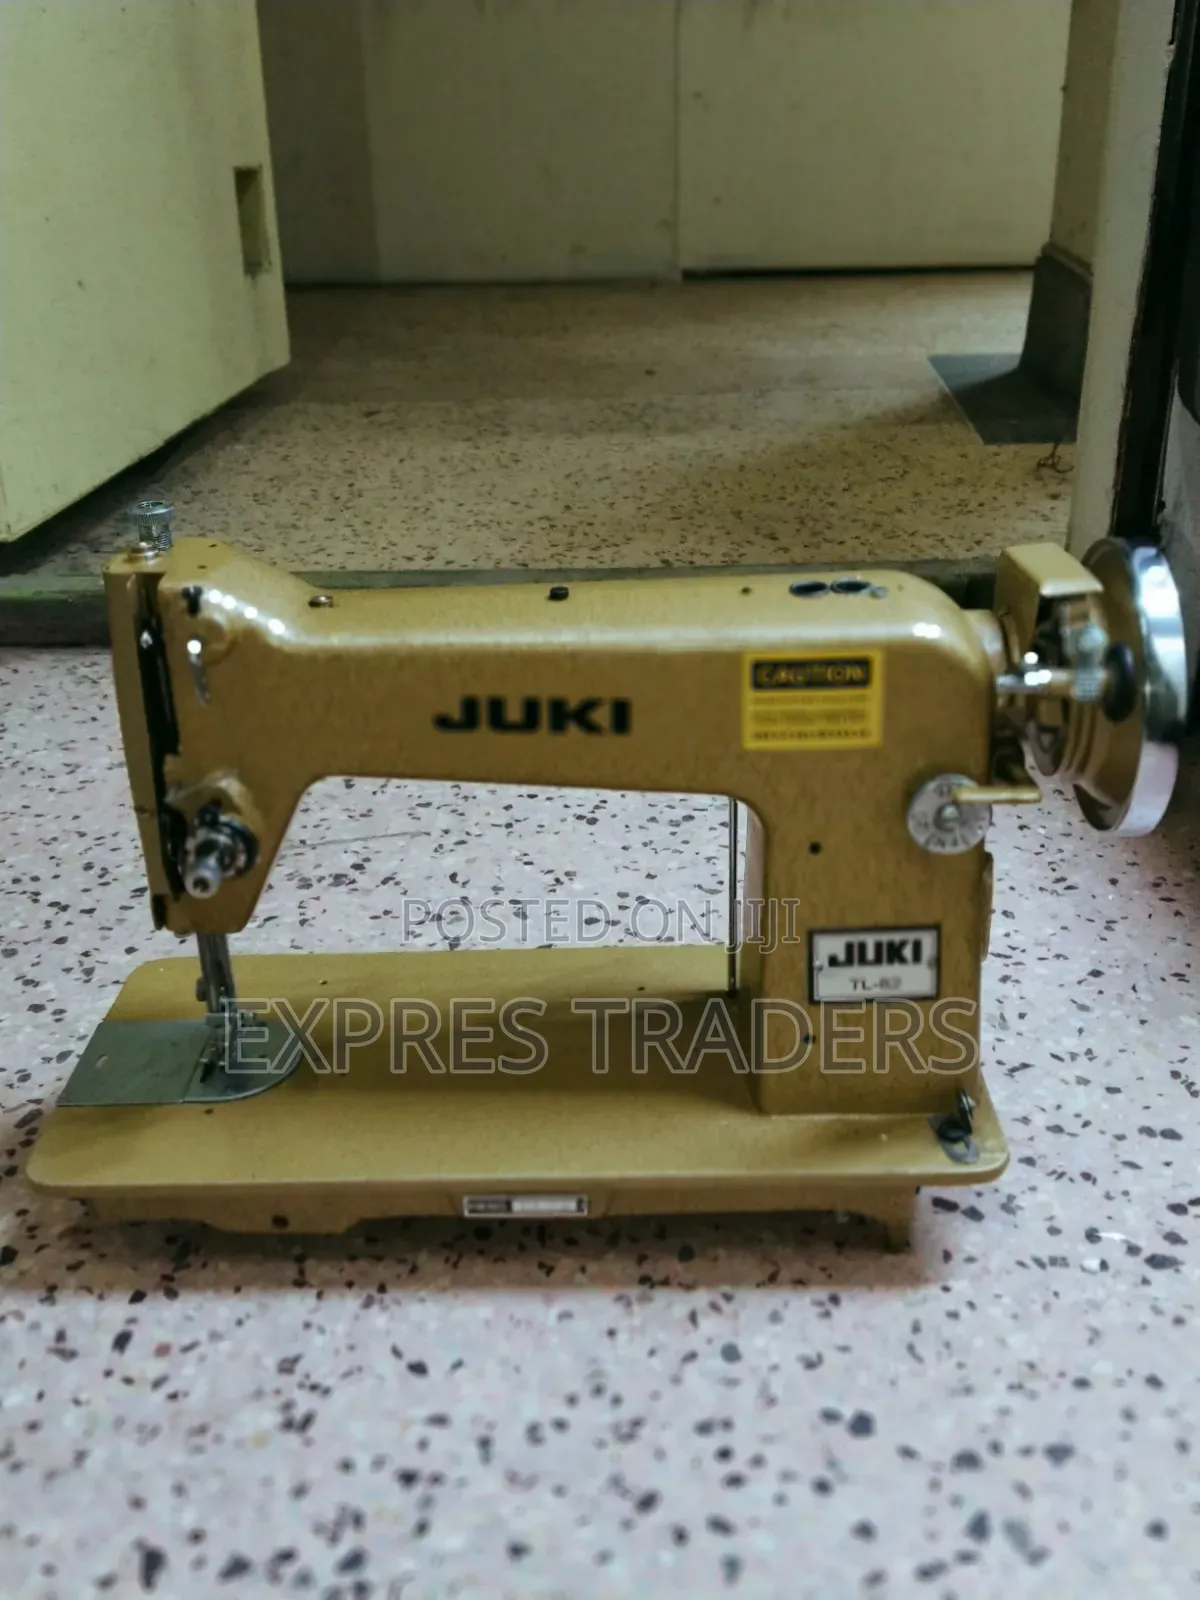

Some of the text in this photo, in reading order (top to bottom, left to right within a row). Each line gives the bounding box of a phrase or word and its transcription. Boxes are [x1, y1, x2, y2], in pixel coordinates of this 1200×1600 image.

[757, 664, 865, 683] CAUTION
[433, 696, 632, 735] JUKI
[828, 939, 923, 967] JUKI
